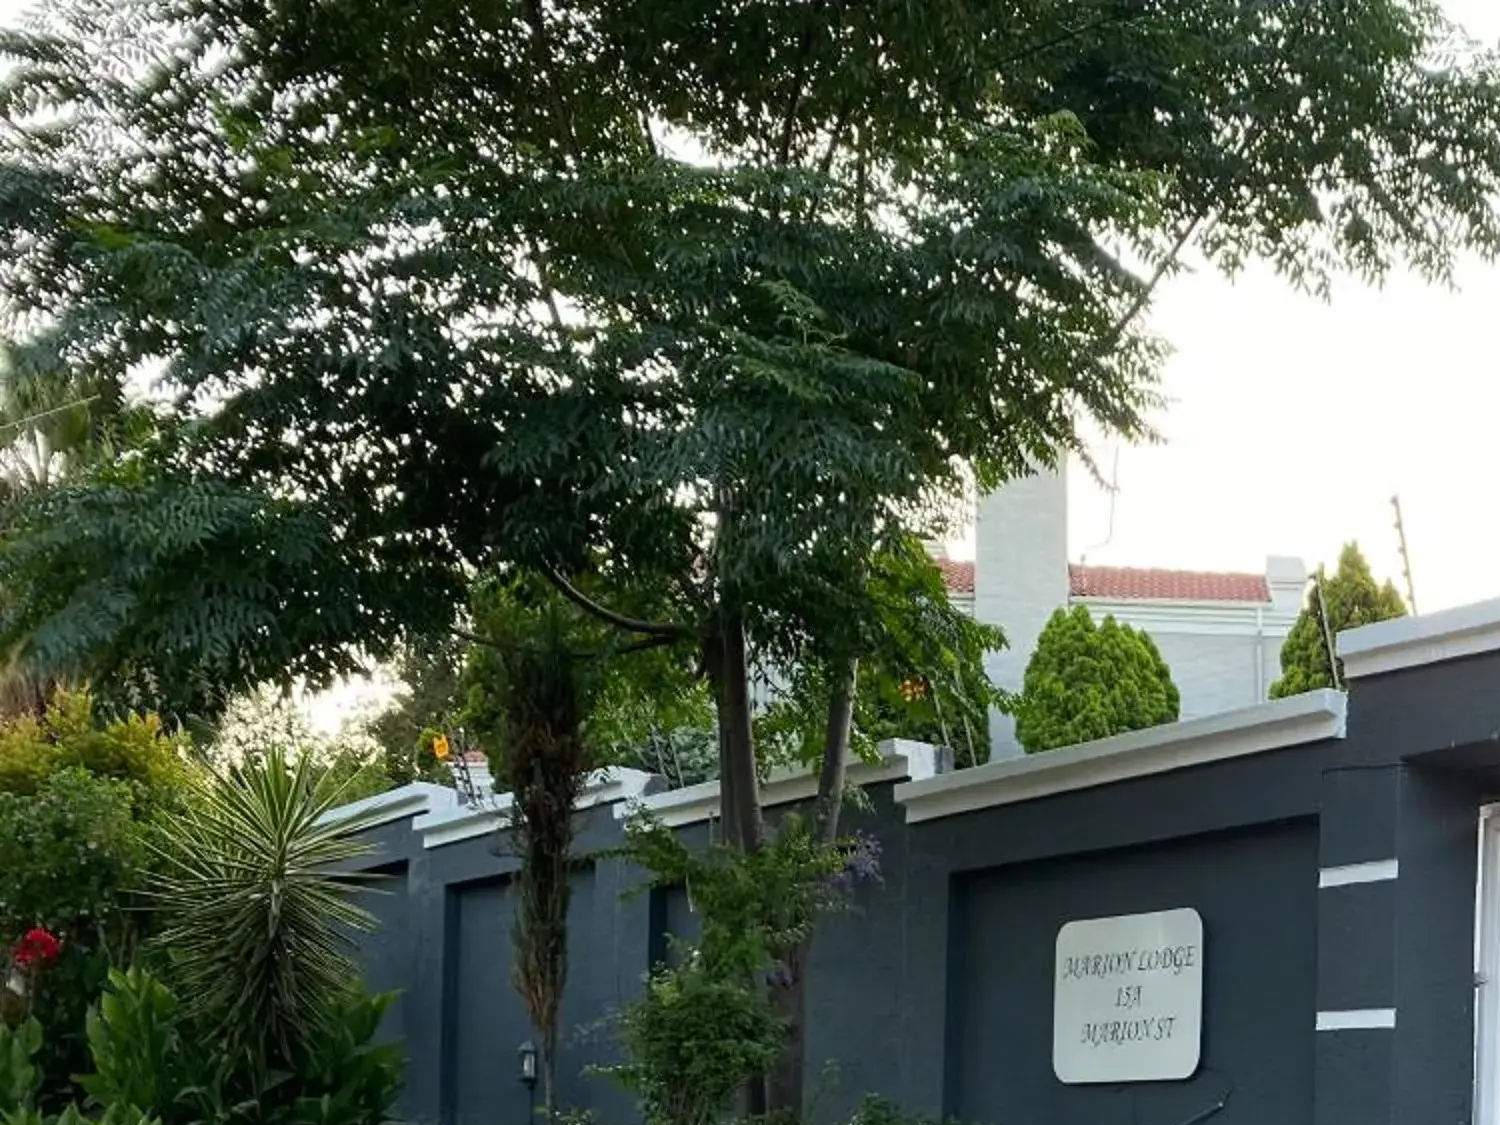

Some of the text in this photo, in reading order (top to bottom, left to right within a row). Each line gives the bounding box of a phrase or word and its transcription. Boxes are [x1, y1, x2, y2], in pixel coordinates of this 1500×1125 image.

[1063, 945, 1197, 980] MARION LODGE
[1081, 1016, 1176, 1047] MARION ST
